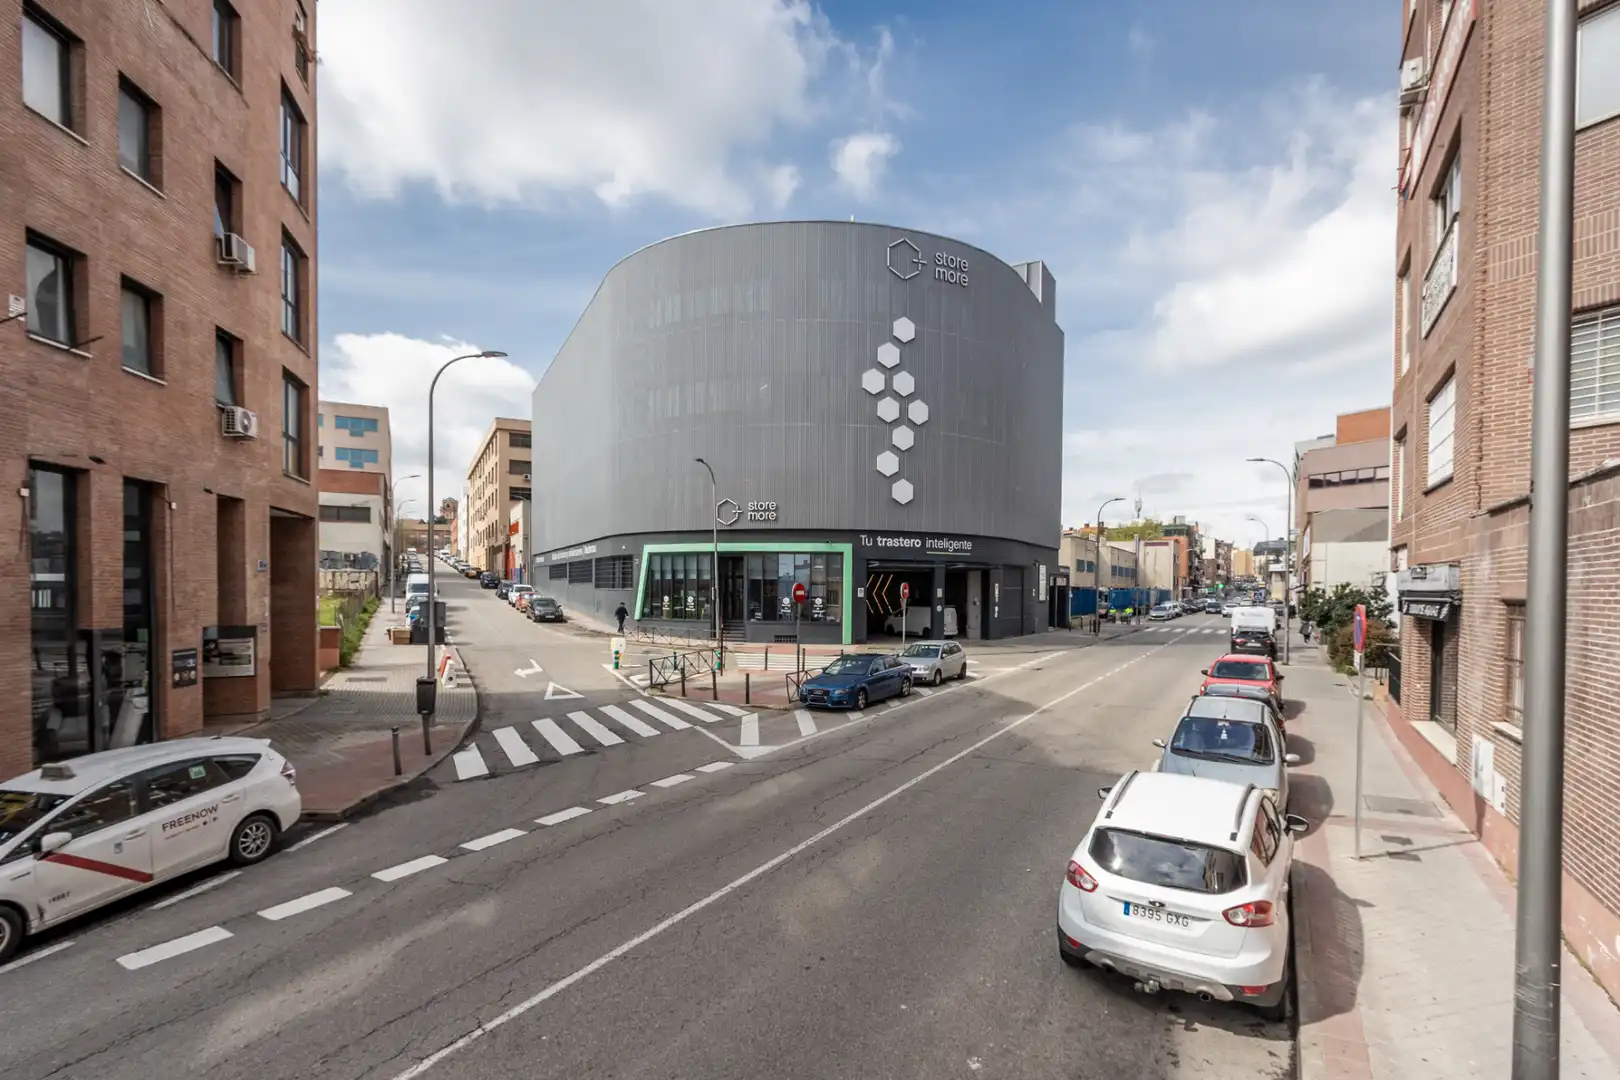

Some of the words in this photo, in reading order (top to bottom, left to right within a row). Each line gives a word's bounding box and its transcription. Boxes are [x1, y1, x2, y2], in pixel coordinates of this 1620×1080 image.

[935, 252, 968, 271] store
[935, 267, 968, 286] more
[748, 501, 776, 510] store
[748, 511, 776, 520] more
[860, 534, 873, 546] Tu
[876, 536, 922, 548] trastero
[925, 537, 973, 552] inteligente
[162, 804, 219, 832] FREENOW
[1132, 904, 1162, 921] 8395
[1166, 912, 1189, 927] GXG
